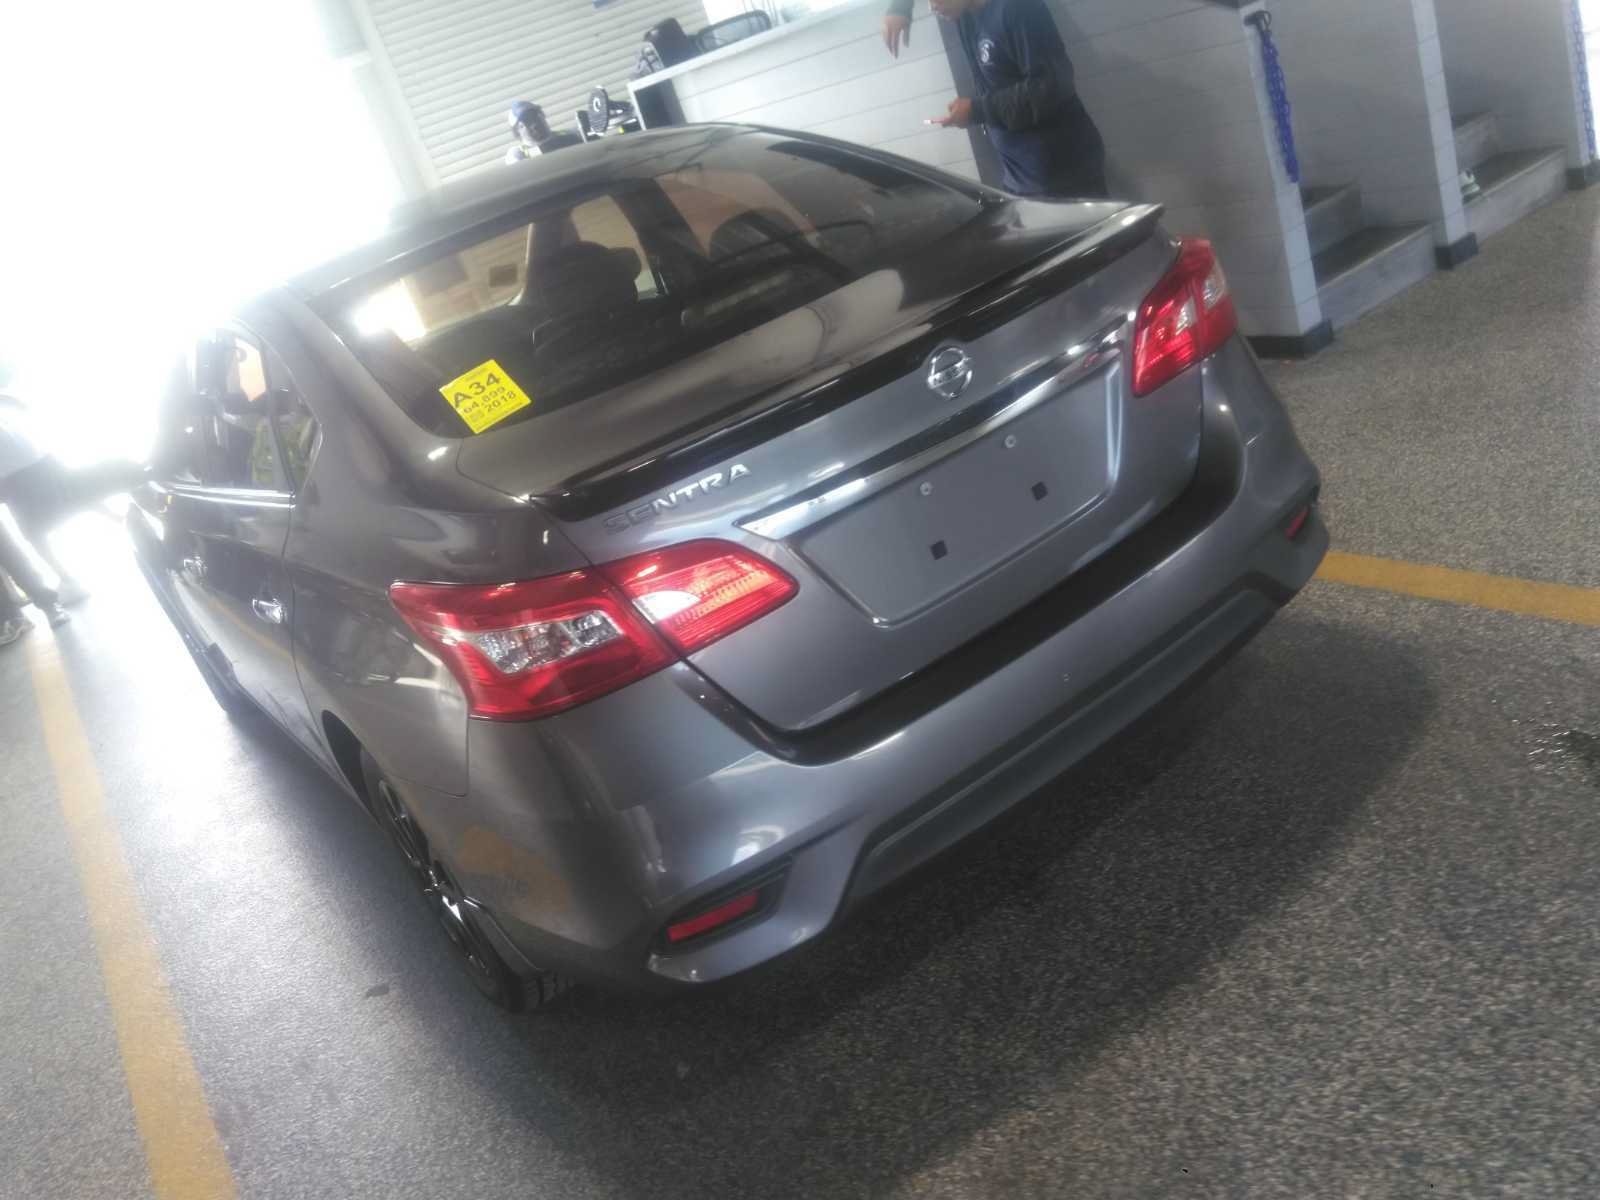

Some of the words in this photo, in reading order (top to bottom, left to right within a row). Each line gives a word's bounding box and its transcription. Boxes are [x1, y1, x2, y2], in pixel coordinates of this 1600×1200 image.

[454, 372, 500, 408] A34
[486, 390, 517, 413] 2018
[602, 463, 750, 535] SENTRA
